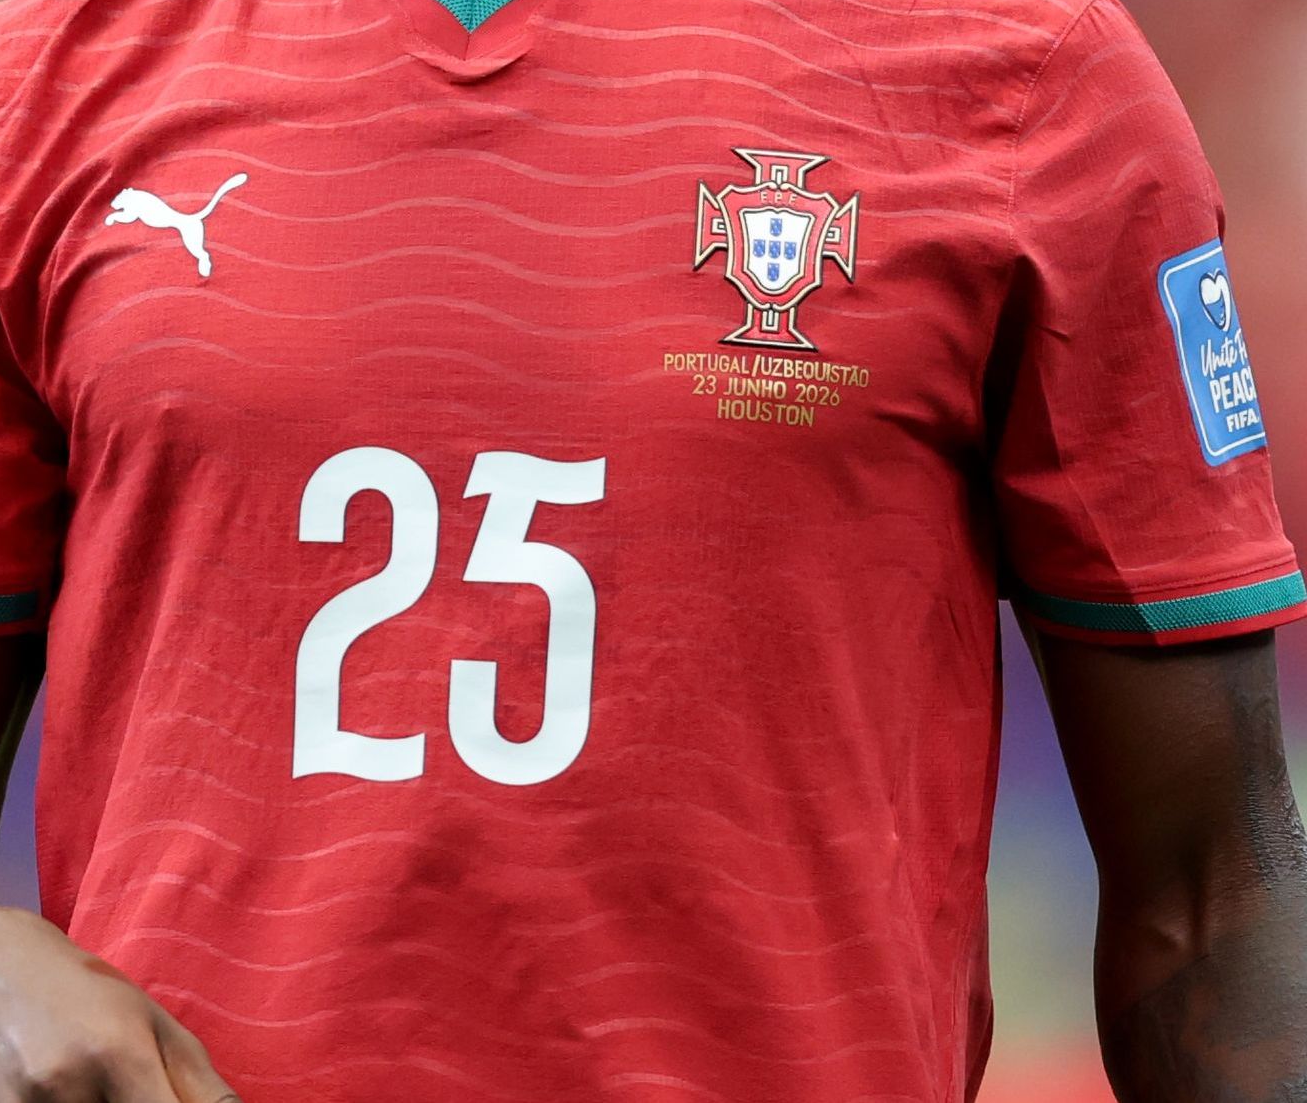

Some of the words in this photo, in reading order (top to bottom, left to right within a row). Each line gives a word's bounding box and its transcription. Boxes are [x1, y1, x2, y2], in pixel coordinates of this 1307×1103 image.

[663, 353, 869, 388] PORTUGAL/UZBEQUISTÃO
[1200, 336, 1237, 378] Unite
[692, 374, 717, 395] 23
[723, 377, 787, 399] JUNHO
[794, 383, 841, 406] 2026
[1209, 365, 1257, 414] PEAC
[717, 398, 816, 427] HOUSTON
[1226, 408, 1260, 433] FIFA
[292, 445, 606, 786] 25
